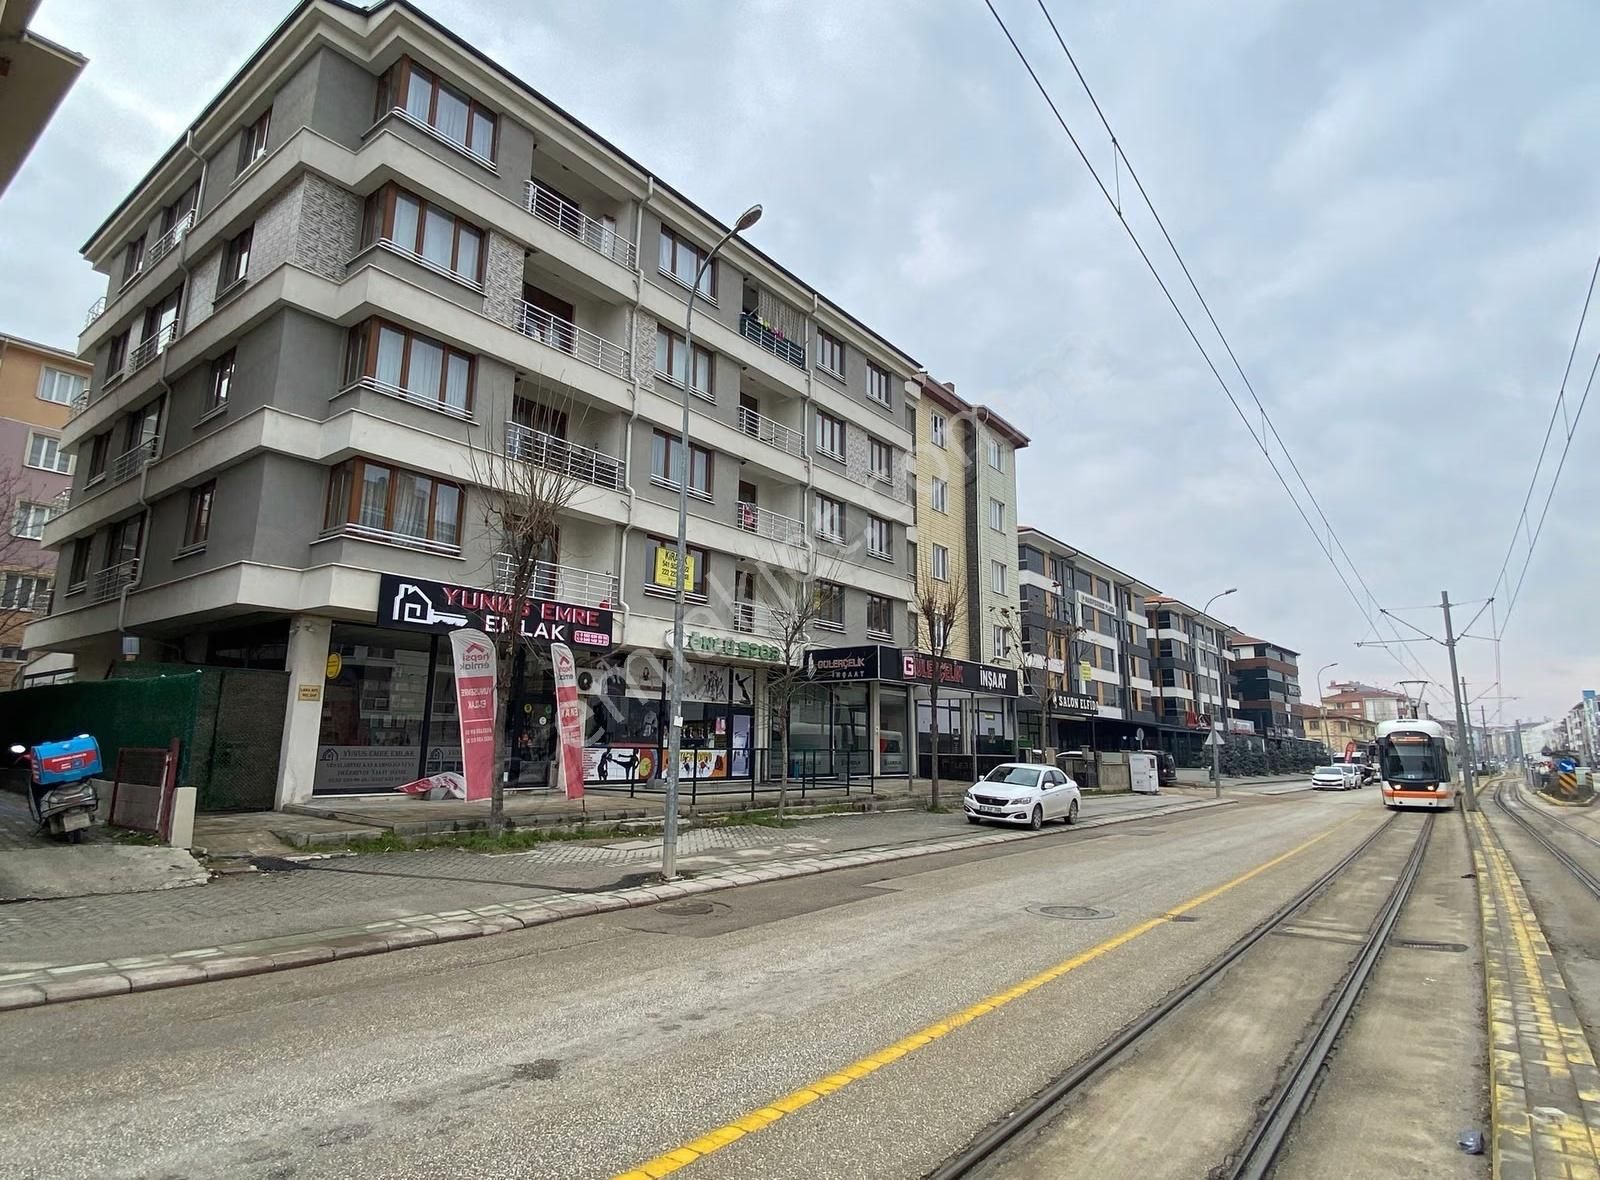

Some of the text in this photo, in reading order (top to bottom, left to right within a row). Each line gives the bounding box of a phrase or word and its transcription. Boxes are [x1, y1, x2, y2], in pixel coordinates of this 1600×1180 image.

[442, 587, 600, 627] YUNUS EMRE
[739, 641, 781, 661] SPOR
[980, 665, 1008, 690] İNŞAAT
[1058, 695, 1079, 709] SALON
